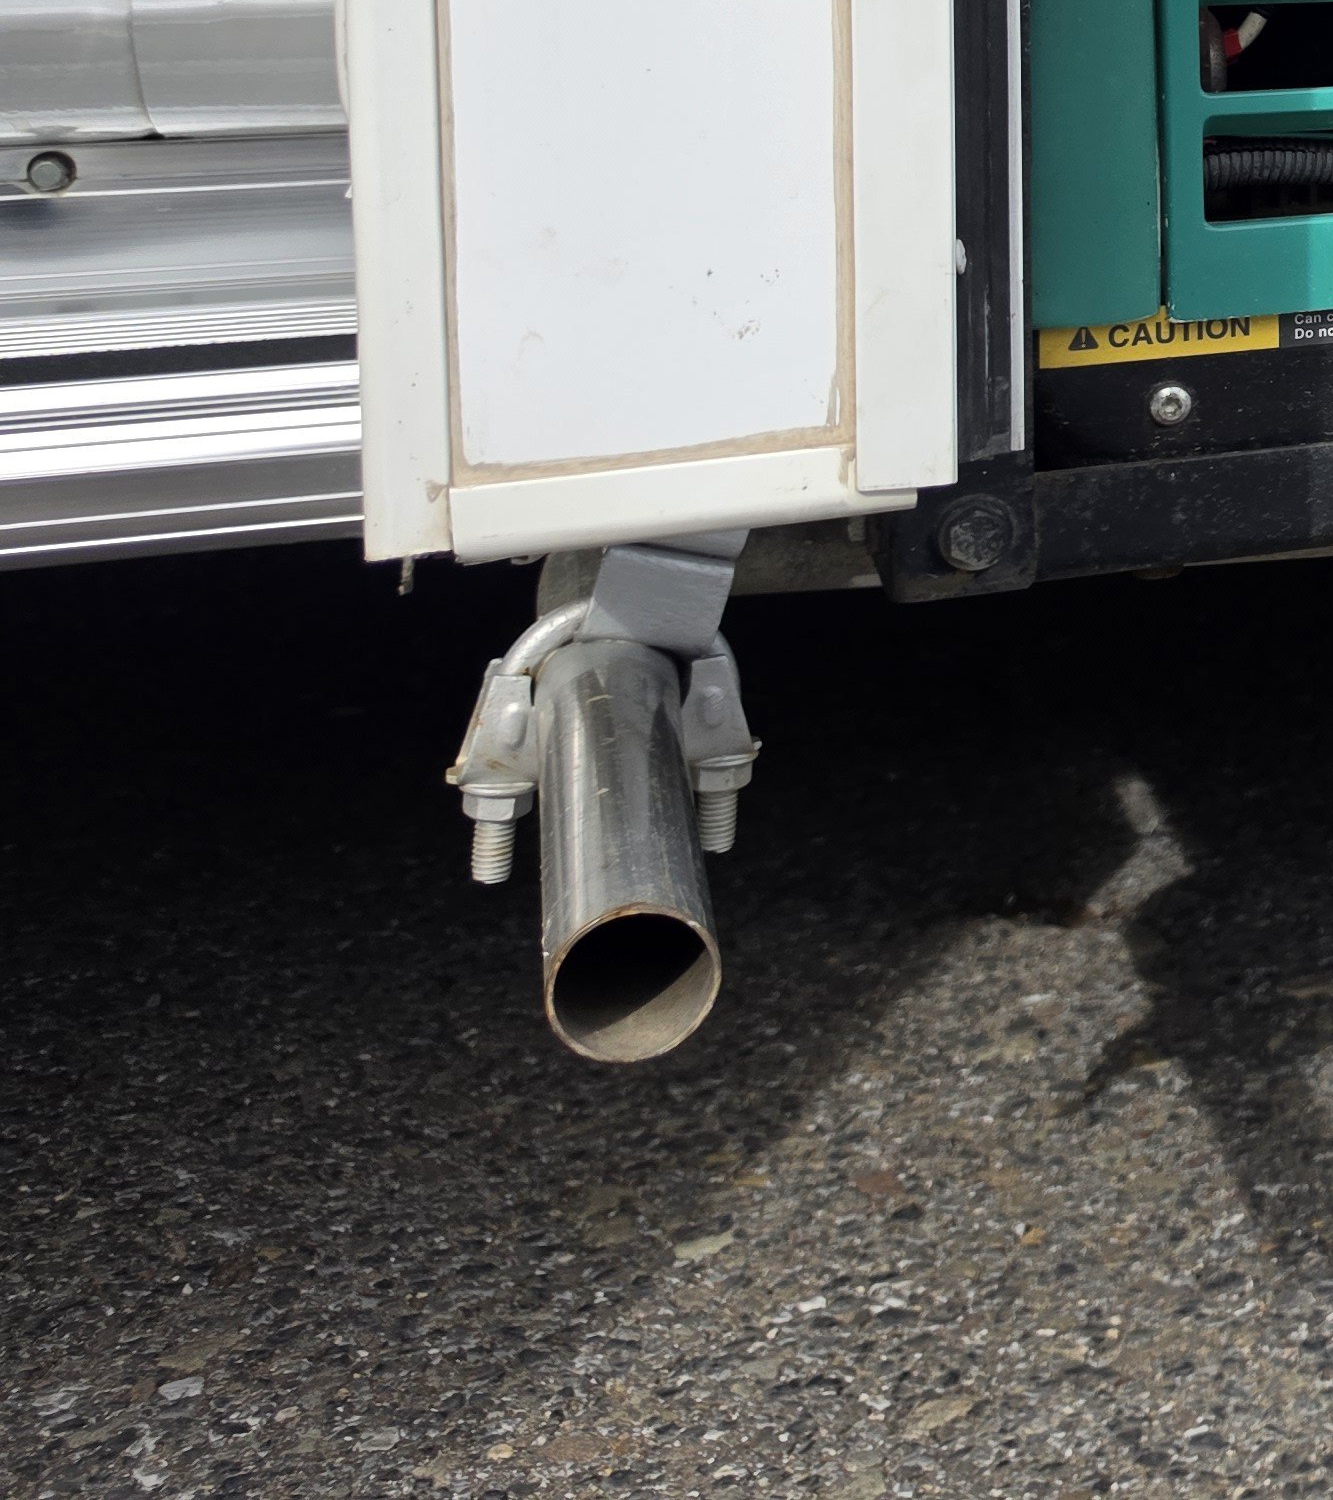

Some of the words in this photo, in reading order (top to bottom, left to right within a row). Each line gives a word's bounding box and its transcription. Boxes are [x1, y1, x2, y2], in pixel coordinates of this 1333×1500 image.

[1294, 313, 1322, 325] Can
[1108, 317, 1251, 348] CAUTION
[1294, 327, 1314, 339] Do
